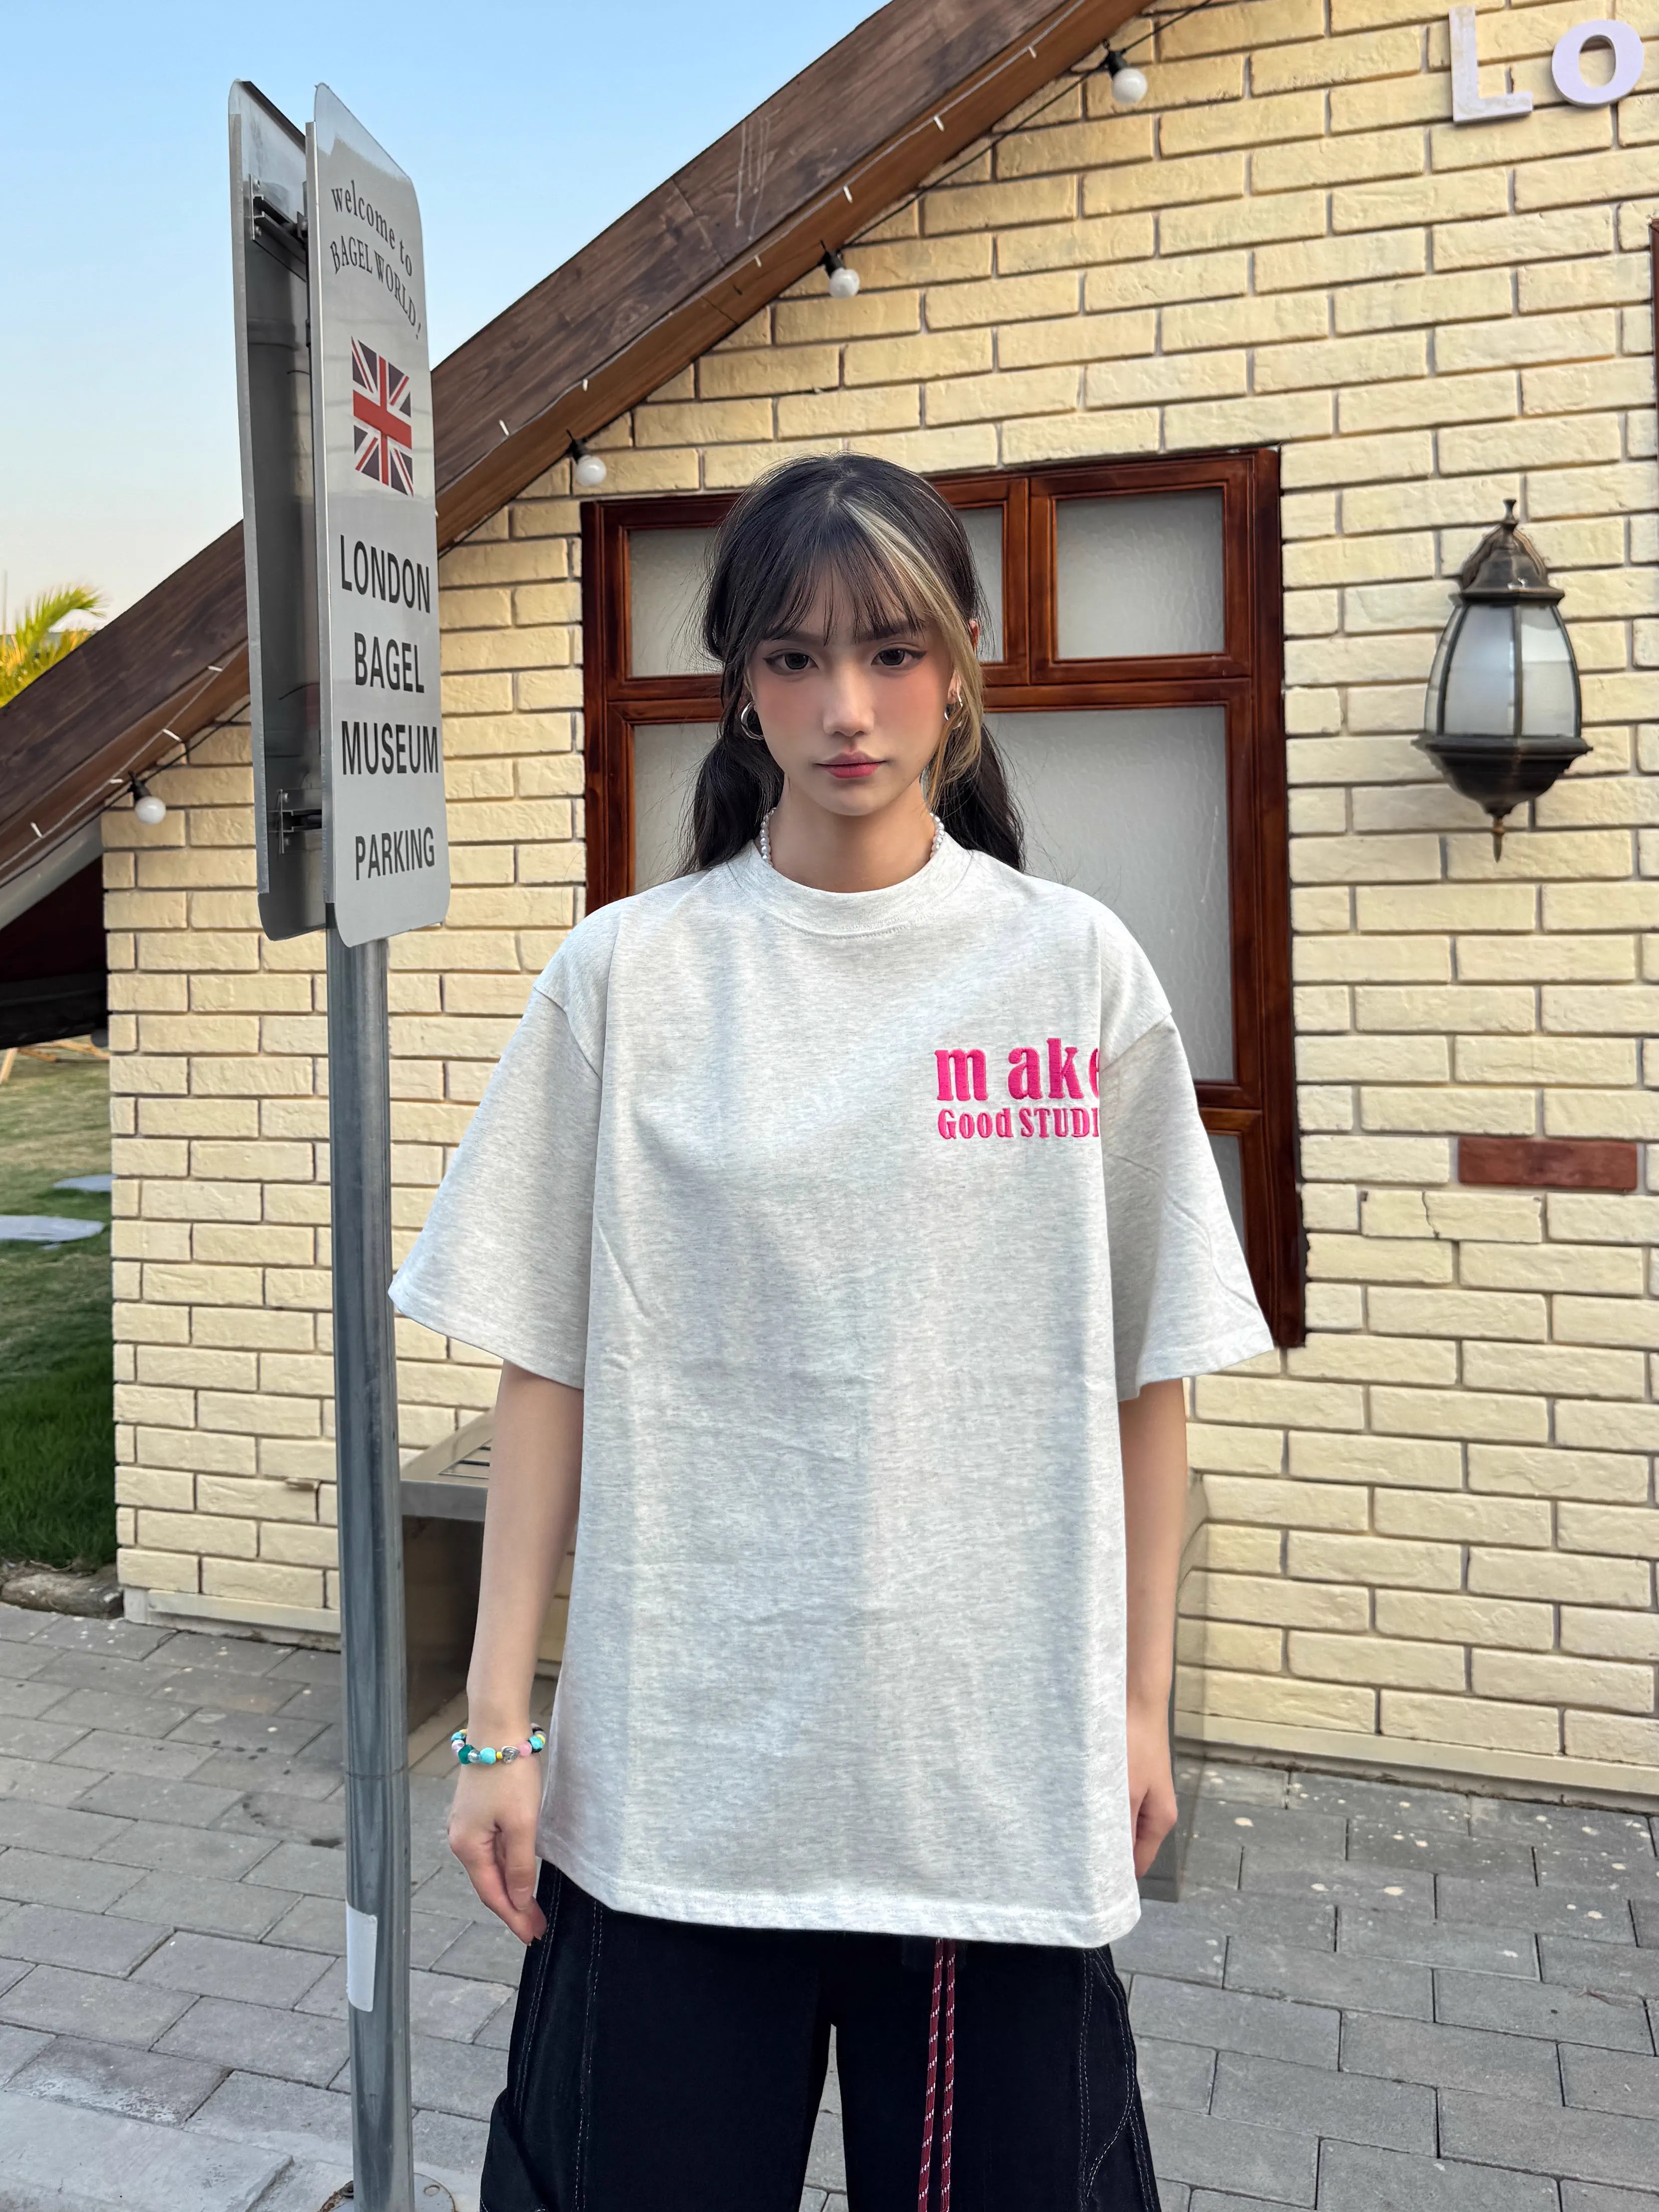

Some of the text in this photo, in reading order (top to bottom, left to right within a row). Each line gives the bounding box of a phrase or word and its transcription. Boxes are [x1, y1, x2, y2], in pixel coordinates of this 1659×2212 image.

[331, 180, 412, 276] welcome to
[330, 235, 421, 340] BAGEL WORLD!
[341, 534, 430, 613] LONDON
[355, 632, 424, 693] BAGEL
[342, 721, 438, 775] MUSEUM
[356, 827, 434, 881] PARKING
[937, 1108, 1014, 1139] Good
